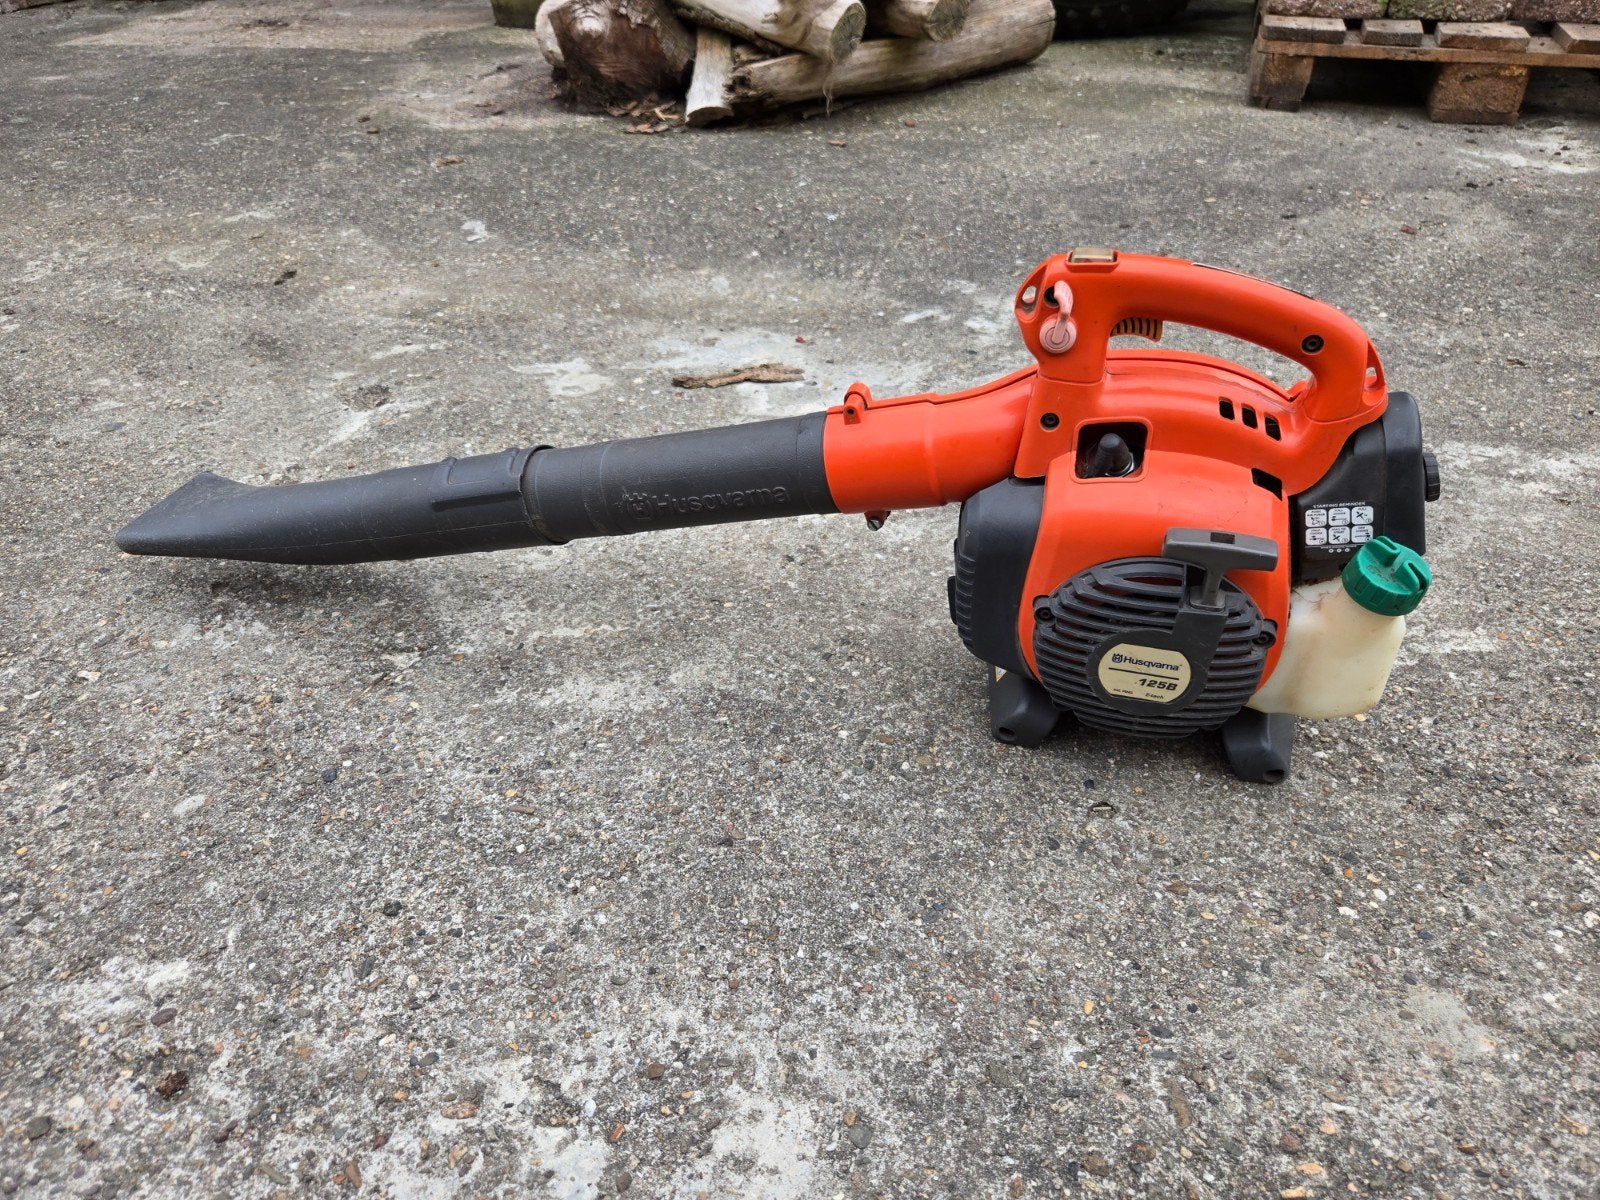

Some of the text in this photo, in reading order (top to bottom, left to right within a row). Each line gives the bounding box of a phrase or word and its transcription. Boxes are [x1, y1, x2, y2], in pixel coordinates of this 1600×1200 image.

[652, 486, 791, 514] Husqvarna
[1123, 656, 1179, 671] Husqvarna
[1139, 678, 1178, 691] 125B
